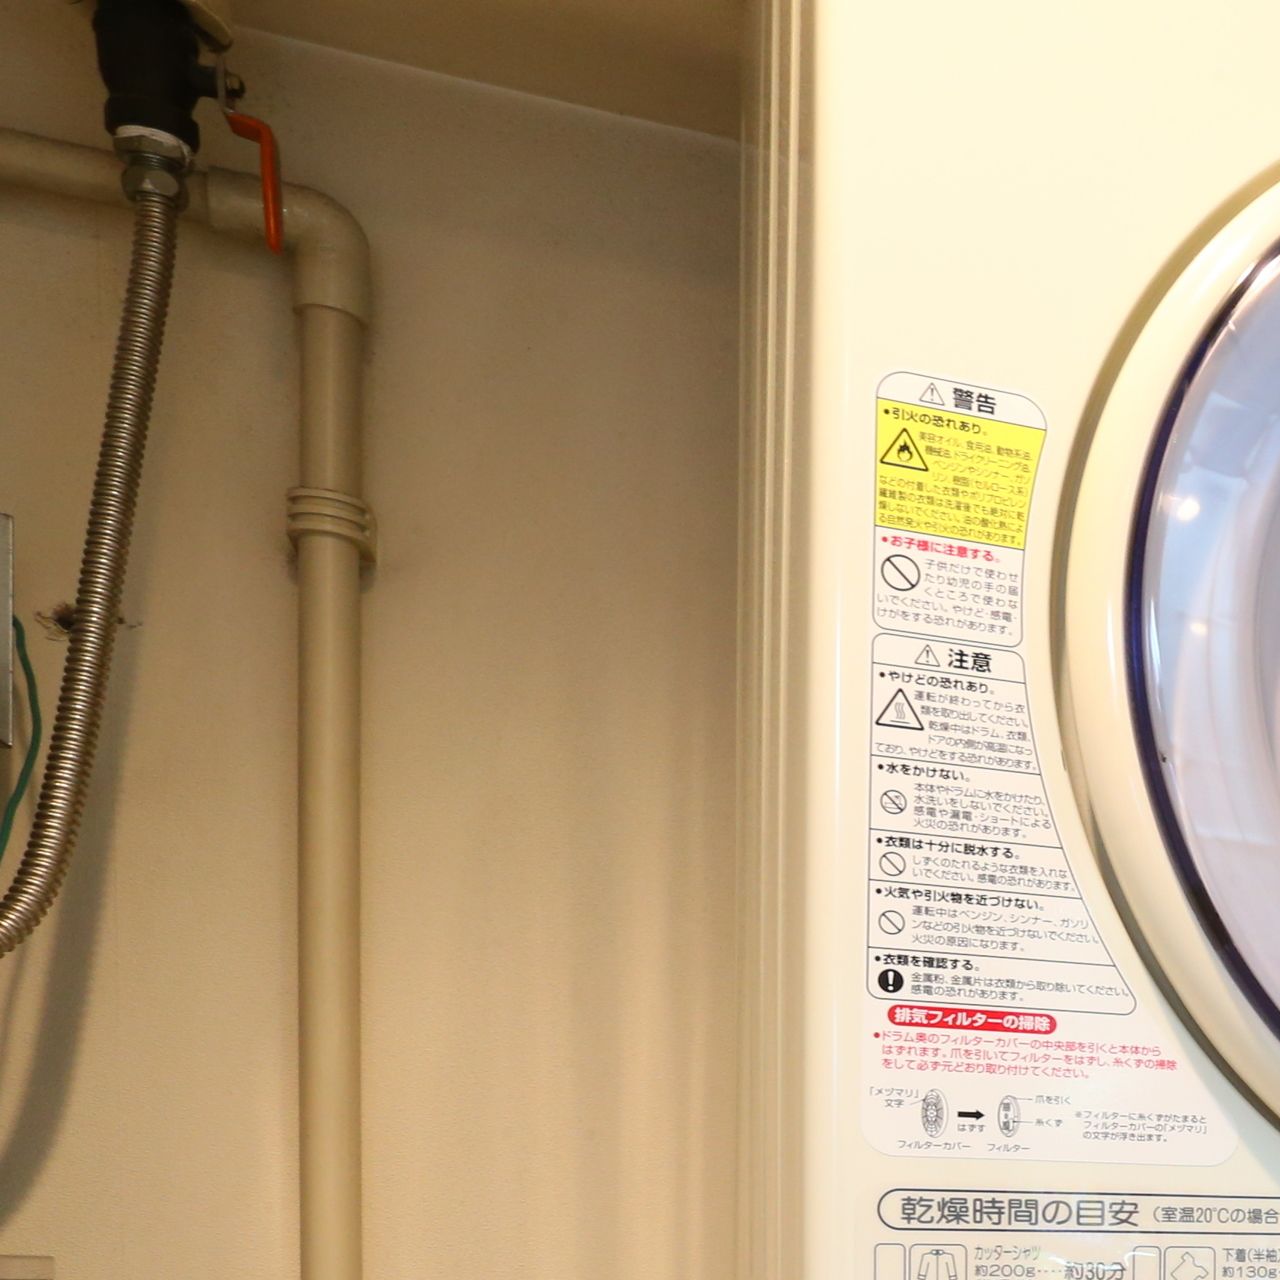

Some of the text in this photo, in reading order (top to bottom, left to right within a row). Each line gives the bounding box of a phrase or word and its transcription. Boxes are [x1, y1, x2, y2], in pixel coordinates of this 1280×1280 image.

[952, 386, 997, 415] 警告
[891, 407, 988, 436] 引火の恐れあり。
[890, 535, 1001, 563] お子様に注意する。
[948, 649, 992, 674] 注意
[888, 670, 995, 695] やけどの恐れあり。
[886, 762, 970, 783] 水をかけない。
[884, 836, 1020, 860] 衣類は十分に脱水する。
[883, 886, 1045, 911] 火気や引火物を近づけない。
[882, 953, 980, 972] 衣類を確認する。
[894, 1009, 1051, 1031] 排気フィルターの掃除
[900, 1196, 1140, 1228] 乾燥時間の目安
